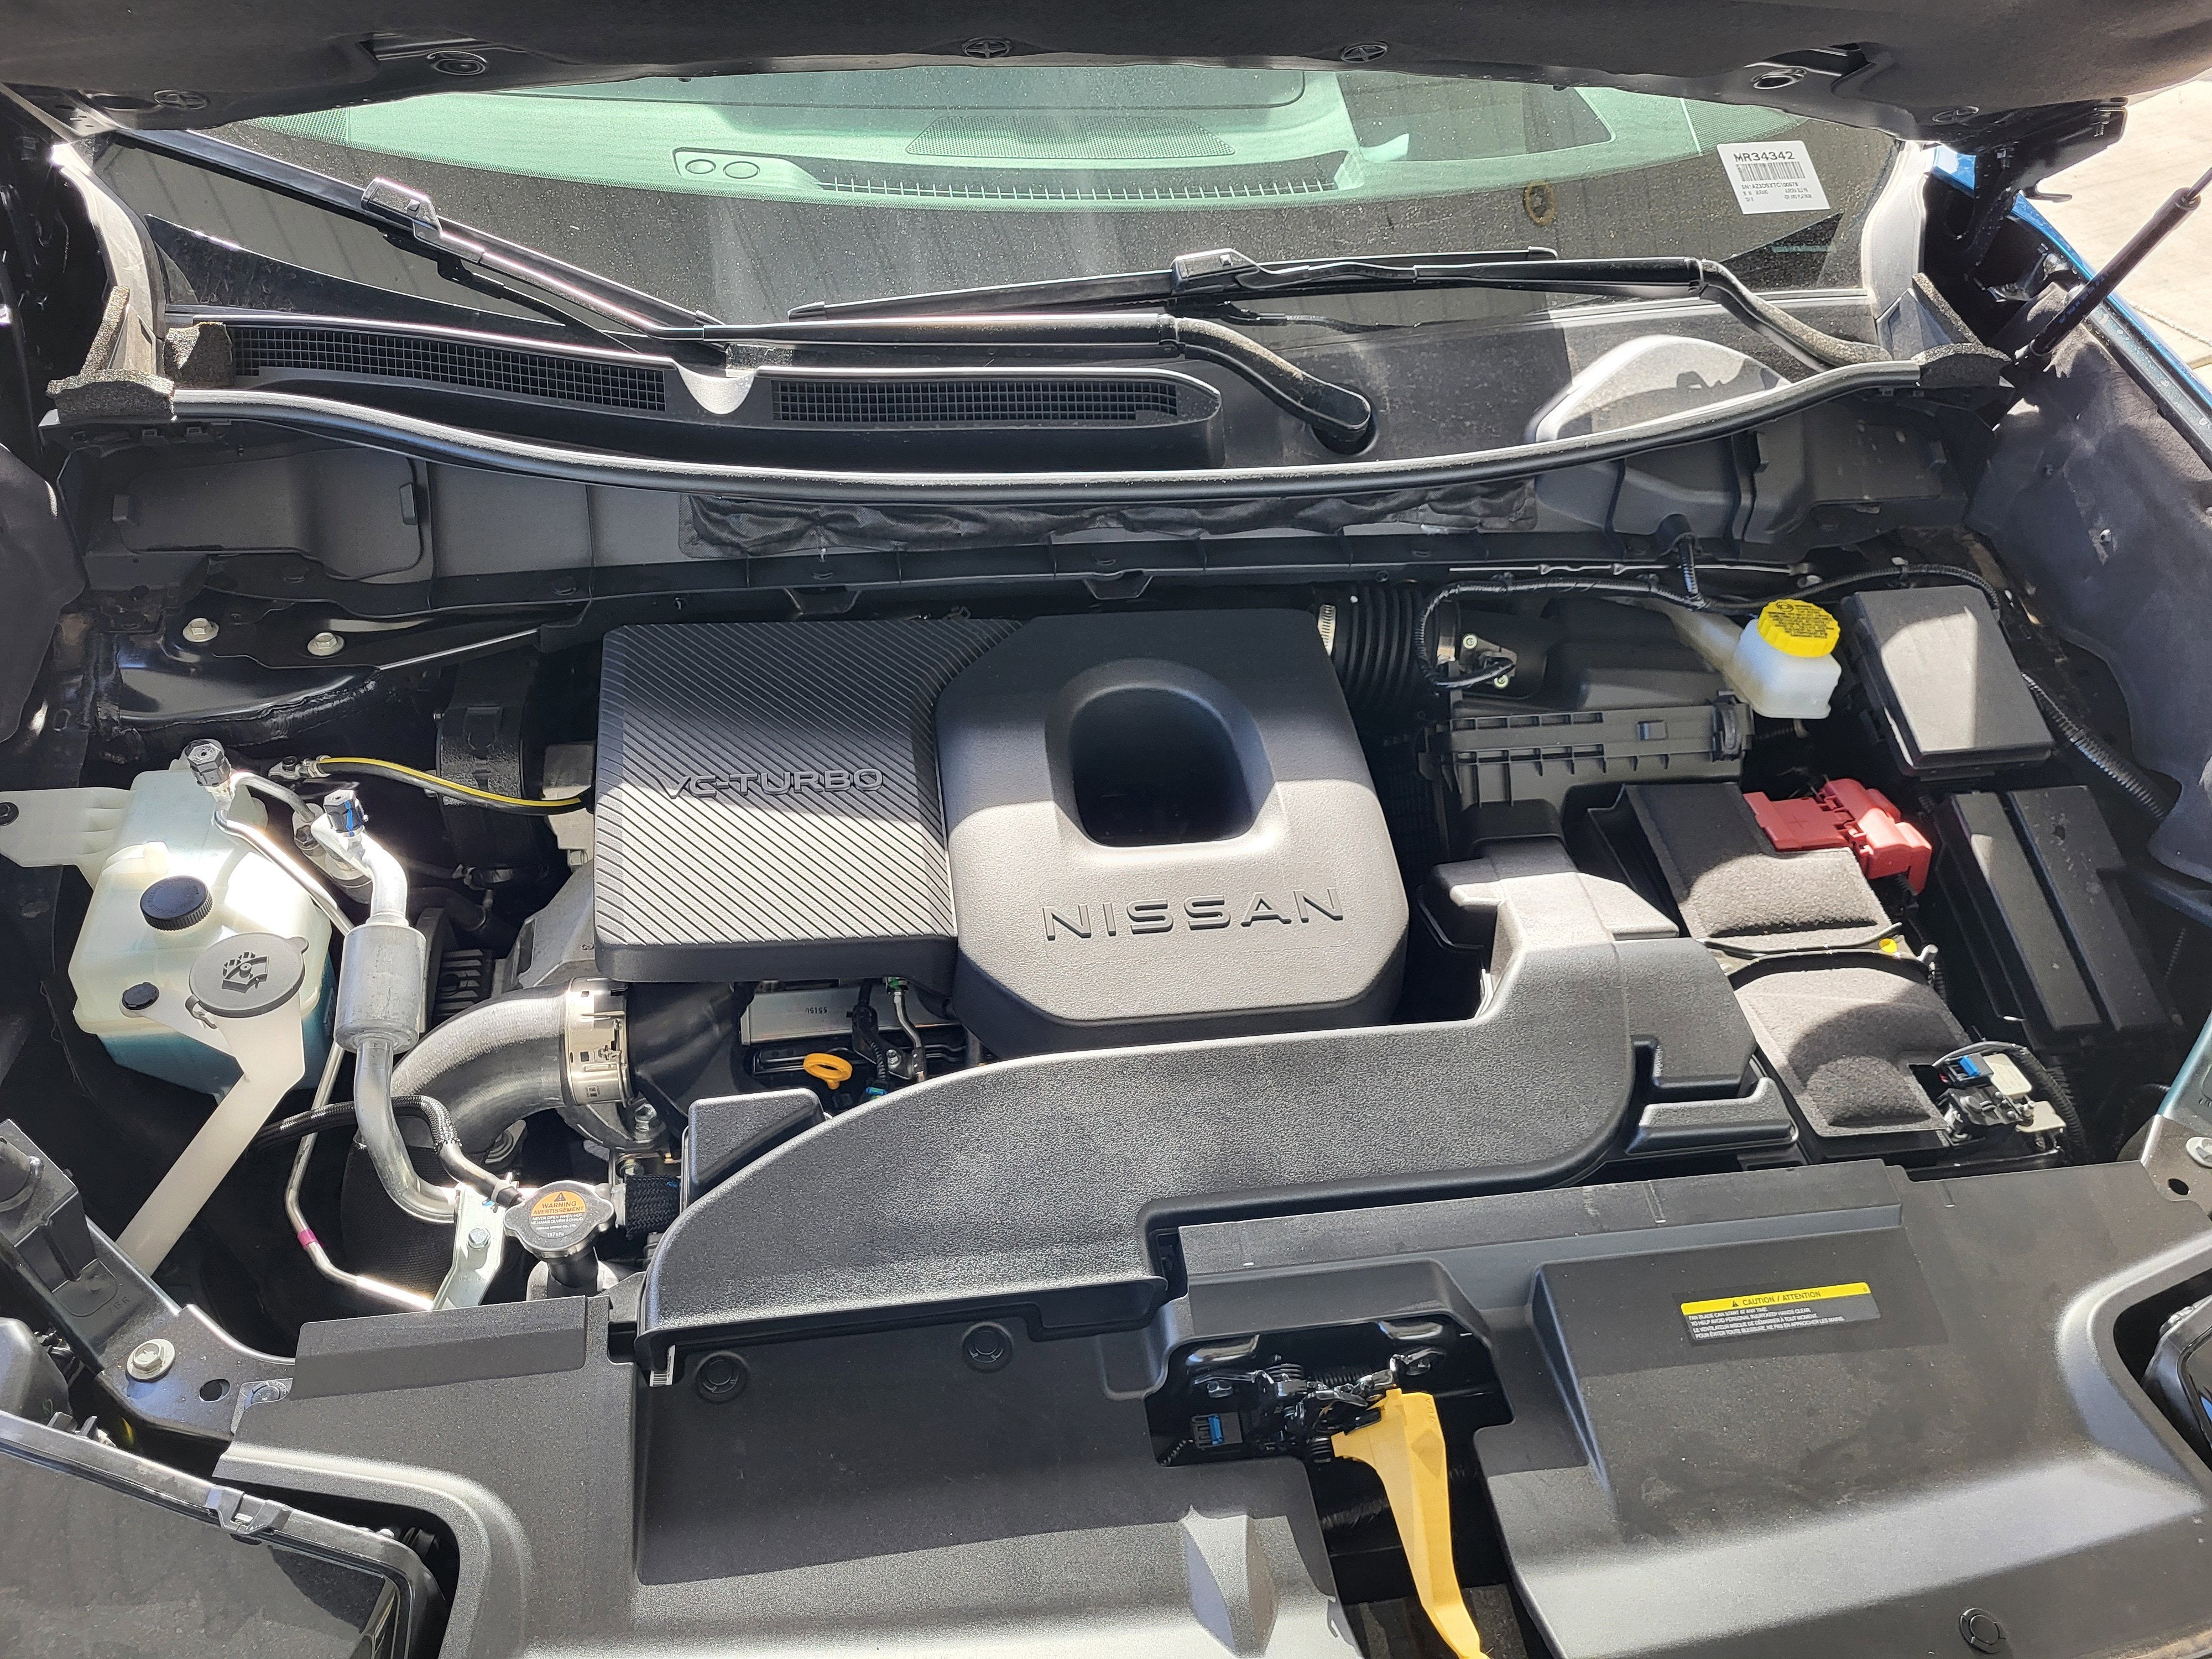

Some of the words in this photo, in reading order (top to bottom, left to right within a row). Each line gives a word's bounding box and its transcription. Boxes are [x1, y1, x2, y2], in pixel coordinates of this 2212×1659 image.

[1733, 151, 1795, 162] MR34342
[658, 768, 884, 799] VC-TURBO
[1042, 887, 1344, 941] NISSAN
[533, 1206, 584, 1215] AVERTISSEMENT
[1743, 1295, 1775, 1306] CAUTION
[1782, 1291, 1821, 1301] ATTENTION
